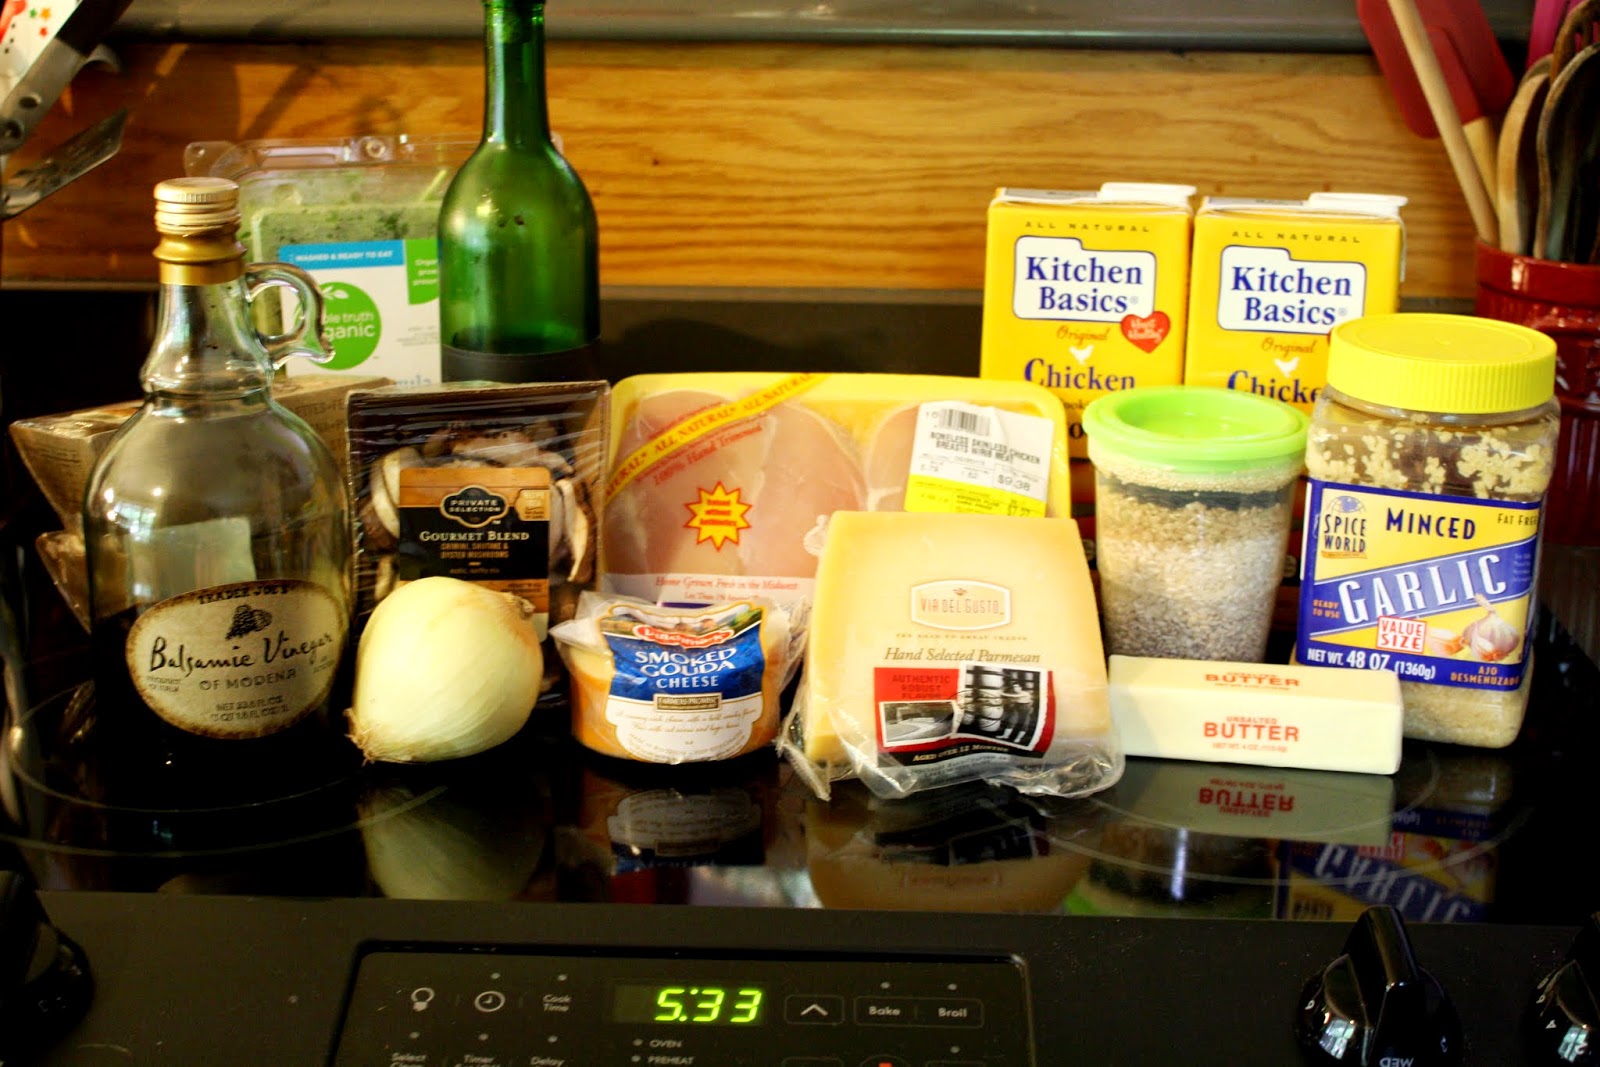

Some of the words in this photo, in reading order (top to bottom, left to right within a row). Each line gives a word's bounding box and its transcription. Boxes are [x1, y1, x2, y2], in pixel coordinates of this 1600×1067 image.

[1025, 221, 1056, 229] ALL
[1069, 223, 1150, 233] NATURAL
[1232, 231, 1263, 239] ALL
[1277, 233, 1360, 244] NATURAL
[1025, 256, 1144, 286] Kitchen
[1230, 266, 1353, 297] Kitchen
[1038, 286, 1129, 314] Basics
[343, 311, 374, 323] truth
[1243, 297, 1337, 326] Basics
[324, 324, 376, 341] ganic
[1056, 324, 1111, 347] Original
[1261, 337, 1318, 358] Original
[1024, 358, 1136, 392] Chicken
[1227, 370, 1322, 402] Chicke
[450, 499, 498, 507] PRIVATE
[1324, 513, 1367, 537] SPICE
[1386, 507, 1477, 540] MINCED
[1324, 535, 1367, 553] WORLD
[197, 586, 251, 604] TRADER
[1338, 554, 1508, 624] GARLIC
[1313, 599, 1340, 609] READY
[1312, 608, 1324, 617] TO
[1324, 609, 1341, 619] USE
[1380, 620, 1423, 637] VALUE
[1380, 634, 1422, 650] SIZE
[149, 636, 254, 678] Balsamic
[263, 630, 334, 666] Vinegar
[634, 648, 738, 668] SMOKED
[884, 648, 922, 661] Hand
[925, 648, 974, 662] Selected
[977, 650, 1041, 664] Parmesan
[640, 661, 737, 678] GOUDA
[1307, 648, 1325, 662] NET
[1346, 650, 1367, 669] 48
[1395, 660, 1436, 681] (1360g)
[1478, 666, 1498, 675] AJO
[199, 679, 219, 691] OF
[226, 668, 297, 690] MODENA
[656, 675, 720, 689] CHEESE
[892, 674, 951, 685] AUTHENTIC
[1205, 674, 1299, 687] BUTTER
[1226, 716, 1278, 725] UNSALTED
[1204, 722, 1300, 742] BUTTER
[912, 753, 937, 762] AGED
[543, 994, 571, 1004] Cook
[543, 1003, 569, 1013] Time
[868, 1005, 900, 1017] Bake
[938, 1006, 968, 1019] Broil
[650, 1039, 683, 1049] OVEN
[391, 1052, 427, 1063] Select
[464, 1054, 496, 1064] Timer
[530, 1056, 566, 1067] Delay
[647, 1056, 695, 1067] PREHEAT
